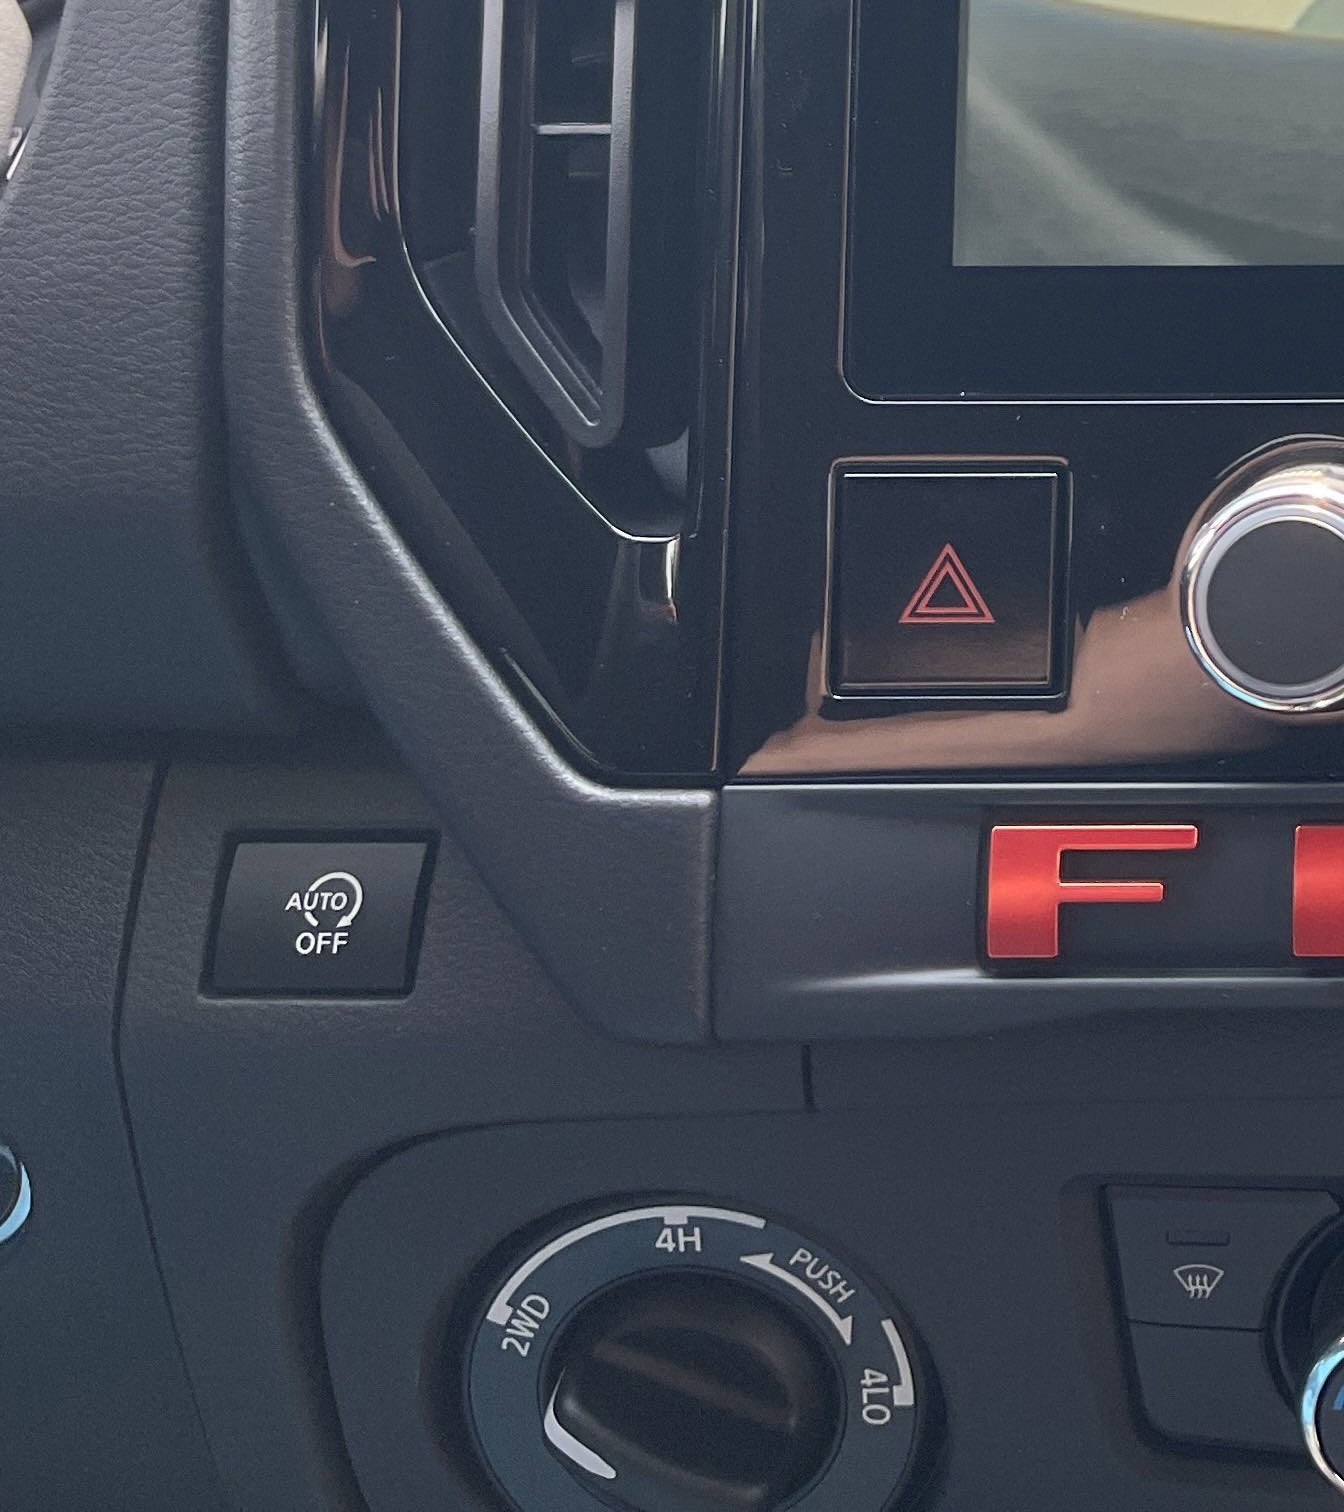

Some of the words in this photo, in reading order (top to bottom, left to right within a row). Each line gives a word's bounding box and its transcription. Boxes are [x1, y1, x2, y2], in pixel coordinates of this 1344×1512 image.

[284, 891, 348, 911] AUTO
[295, 931, 349, 955] OFF
[654, 1226, 702, 1254] 4H
[788, 1247, 857, 1305] PUSH
[501, 1292, 551, 1358] 2WD
[860, 1367, 892, 1426] 4LO
